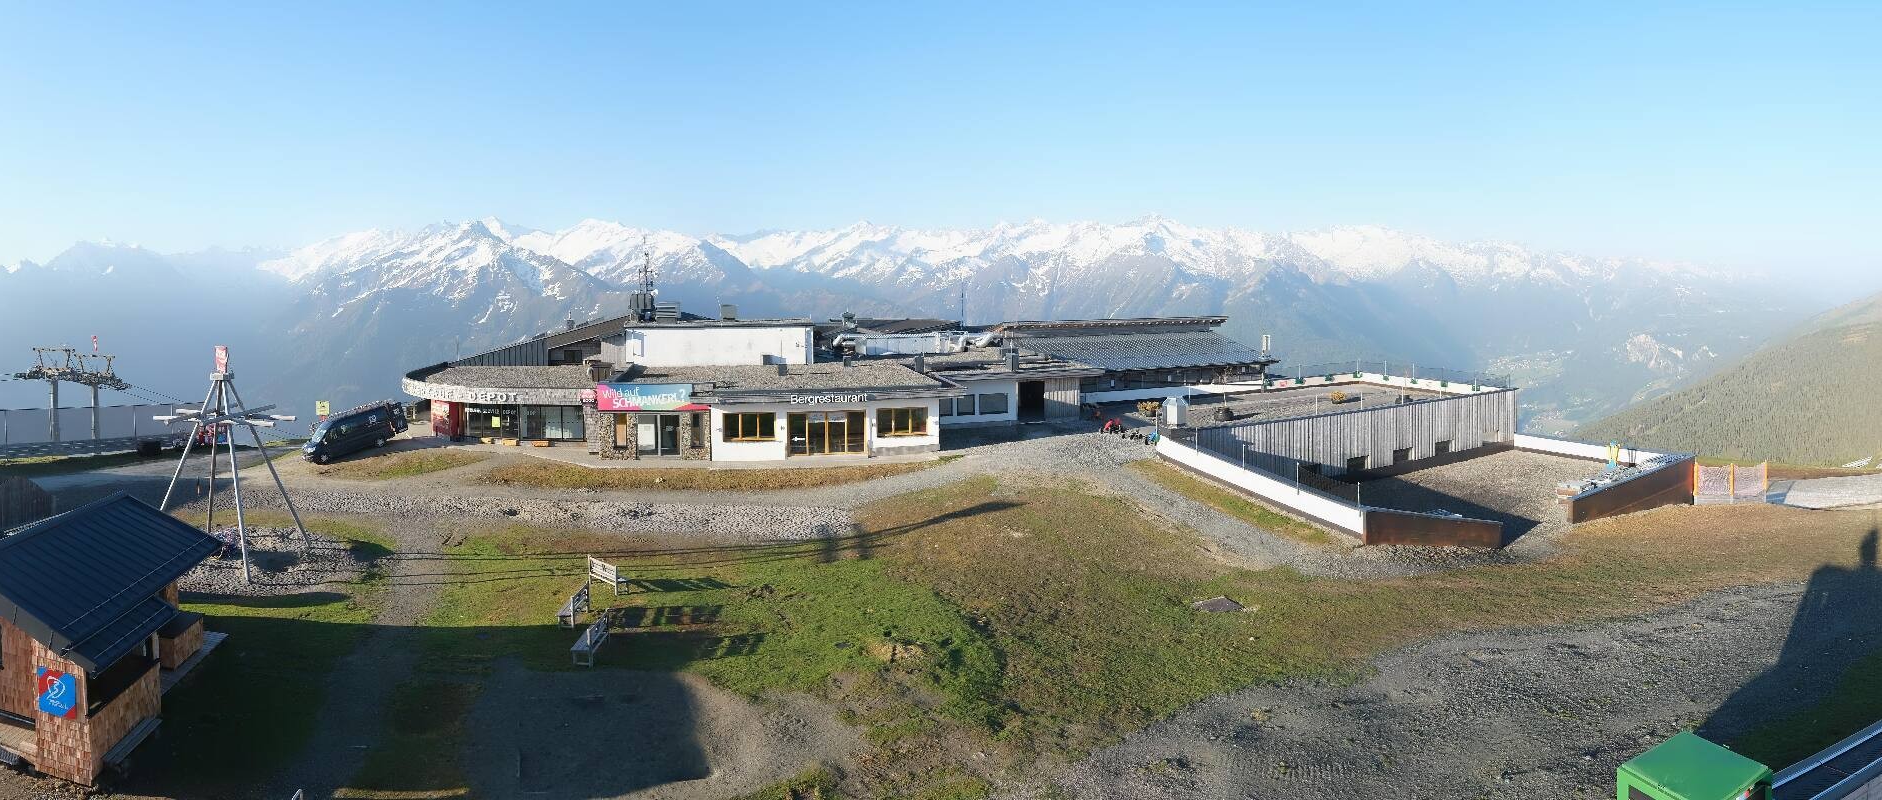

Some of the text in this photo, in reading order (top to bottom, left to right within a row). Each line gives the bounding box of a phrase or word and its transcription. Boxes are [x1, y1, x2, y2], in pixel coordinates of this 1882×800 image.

[602, 388, 623, 399] Wild
[624, 386, 640, 398] auf
[790, 393, 868, 406] Bergrestaurant
